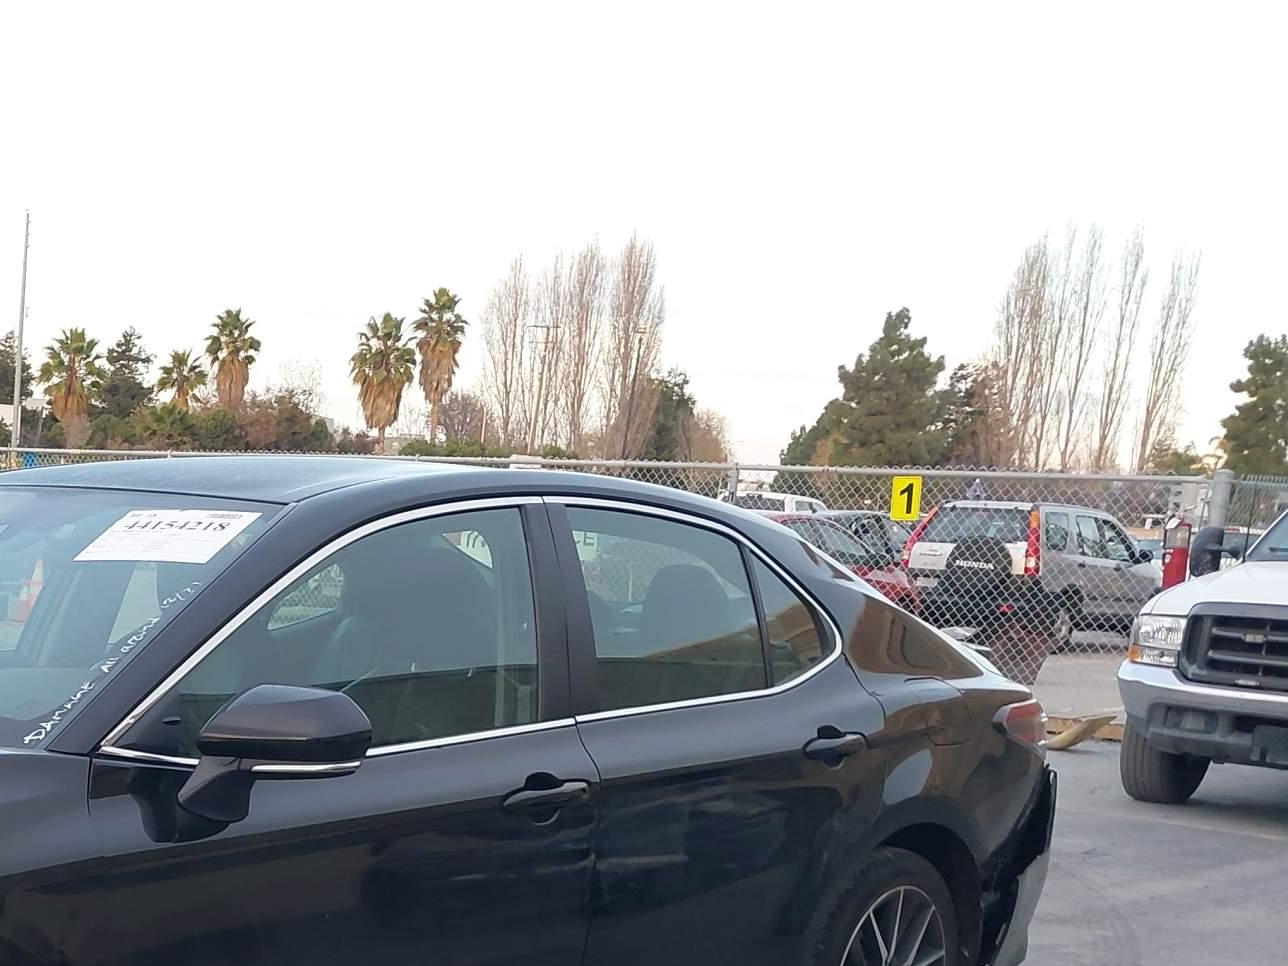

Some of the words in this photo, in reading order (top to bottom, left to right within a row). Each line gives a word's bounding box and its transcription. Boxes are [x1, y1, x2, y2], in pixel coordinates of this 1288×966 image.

[899, 482, 915, 515] 1
[123, 519, 232, 533] 44154218
[954, 559, 995, 570] HONDA
